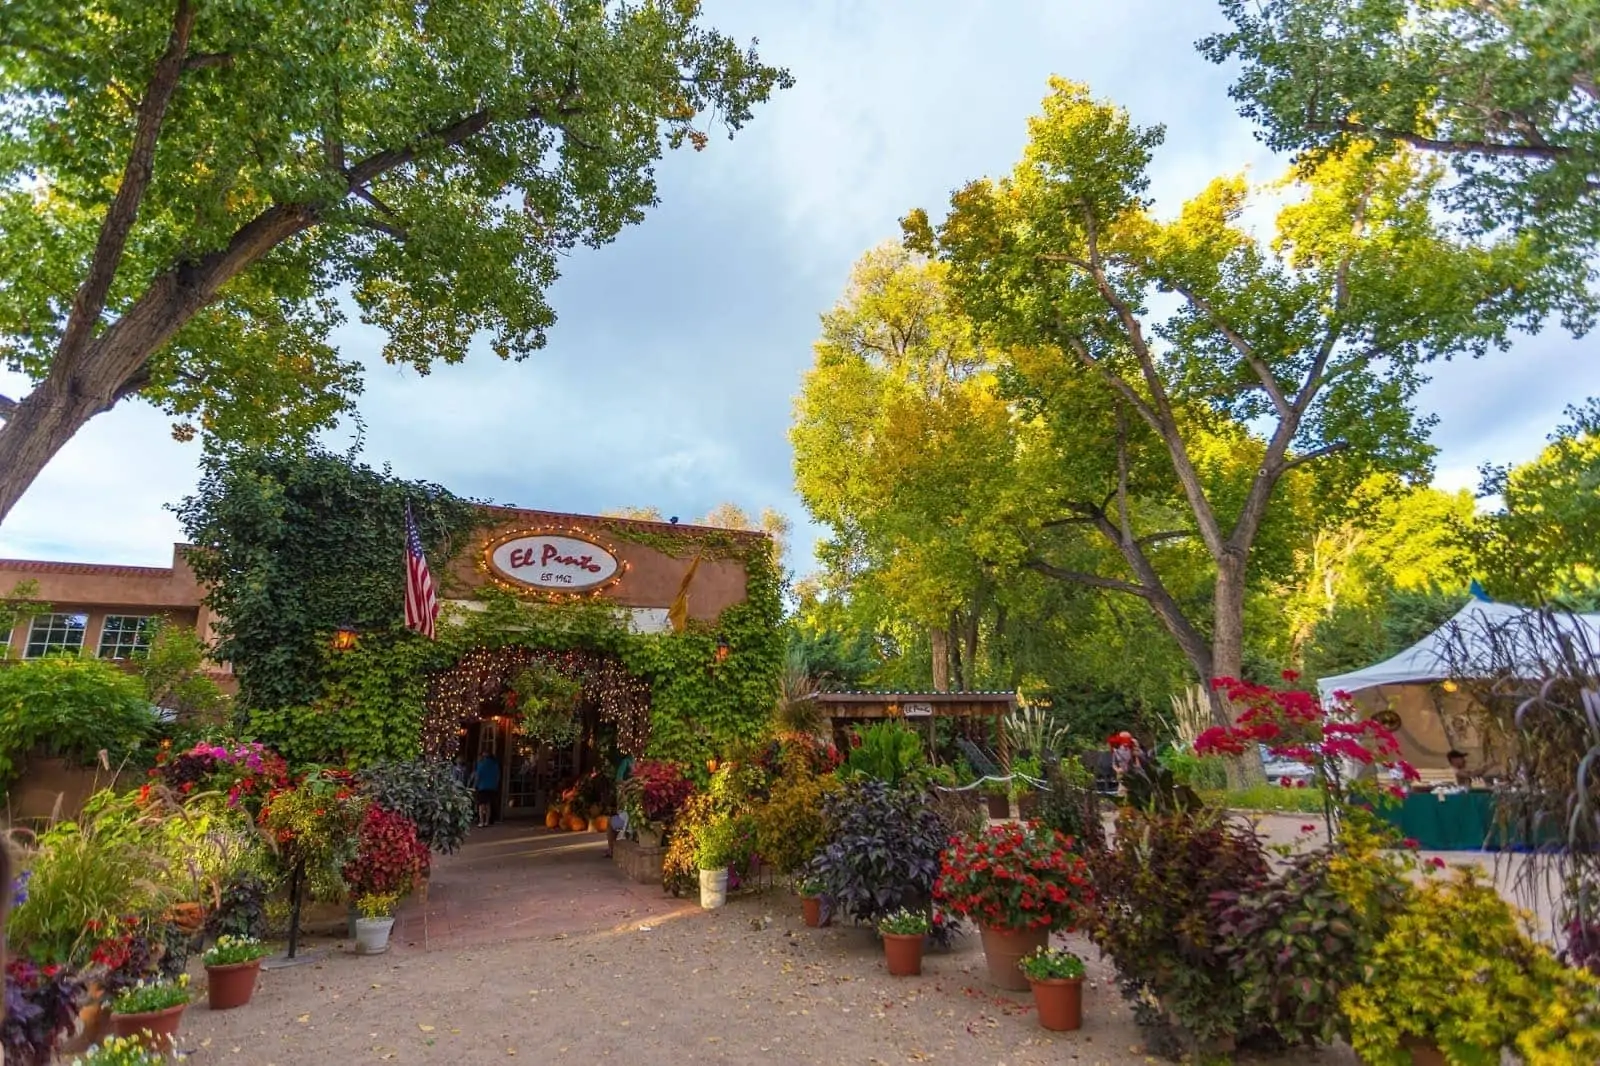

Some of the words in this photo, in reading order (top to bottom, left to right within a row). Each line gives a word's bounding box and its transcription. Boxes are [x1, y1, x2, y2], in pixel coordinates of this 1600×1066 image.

[510, 548, 535, 568] El
[541, 543, 602, 573] Pinto
[555, 574, 573, 584] 1962
